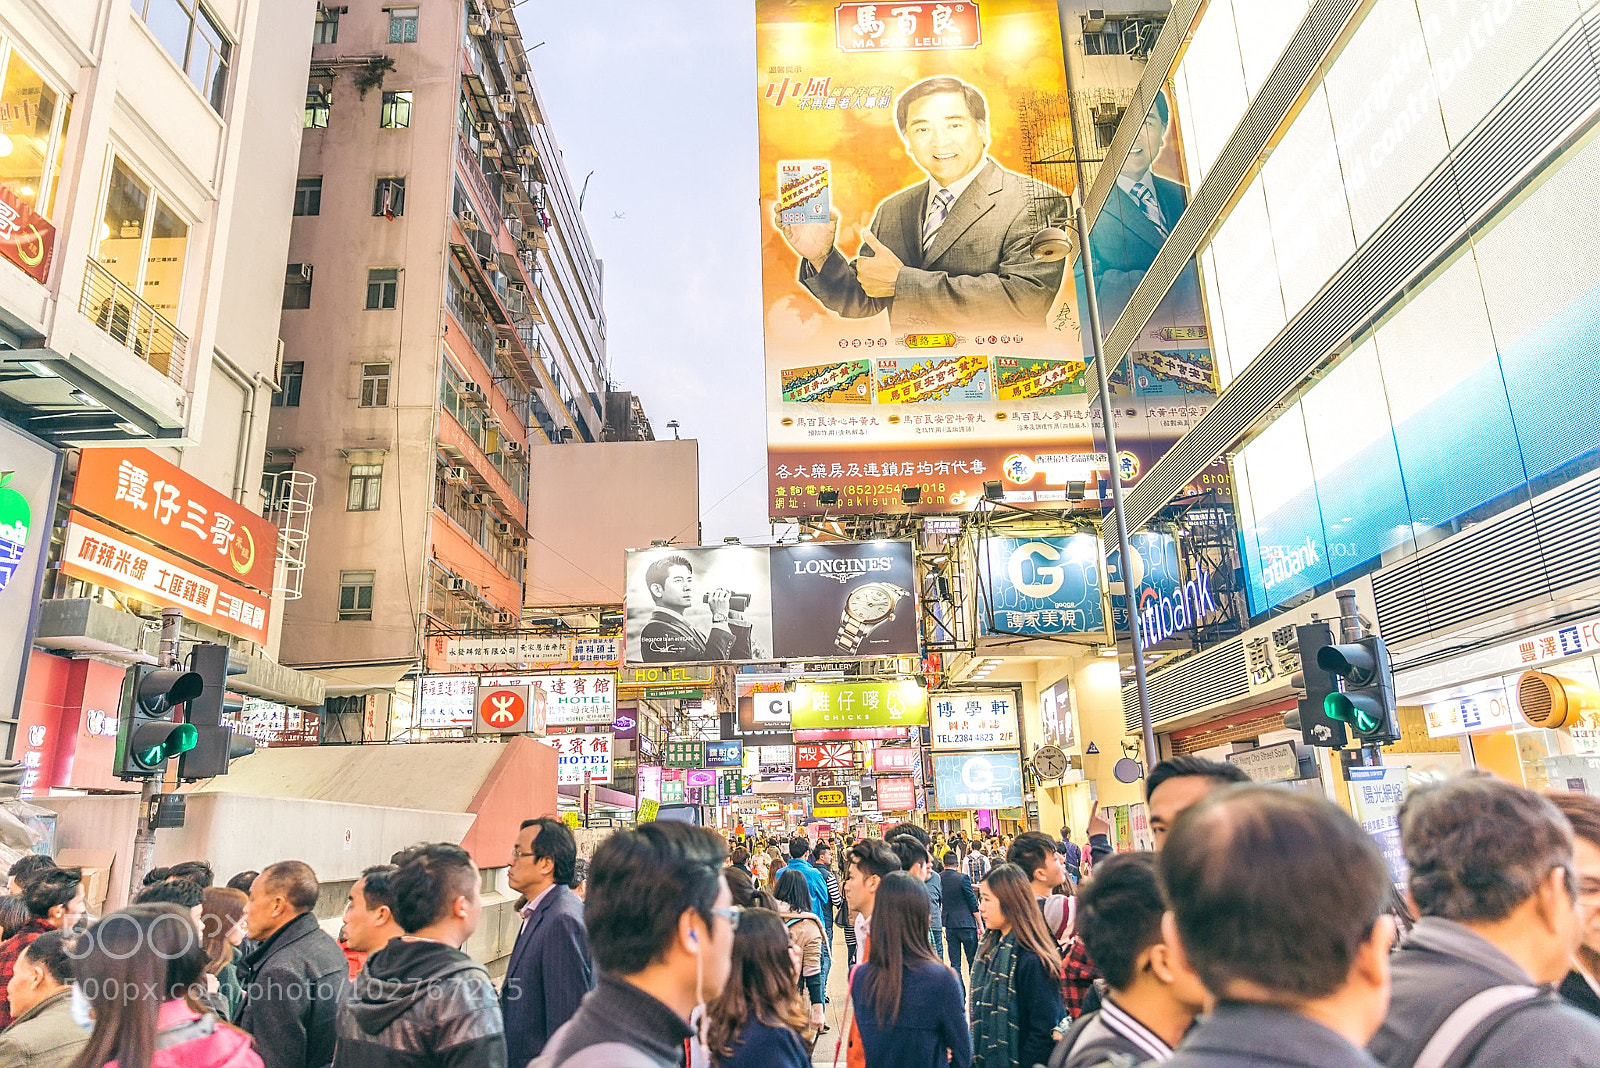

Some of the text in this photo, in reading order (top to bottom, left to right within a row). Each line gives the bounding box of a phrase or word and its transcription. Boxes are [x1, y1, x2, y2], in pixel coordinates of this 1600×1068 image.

[853, 4, 961, 38] 馬百良
[853, 38, 875, 48] MA
[915, 36, 962, 46] LEUNG
[766, 77, 831, 107] 中風
[798, 96, 891, 110] 不再是老人專利
[775, 458, 987, 479] 各大藥房及連鎖店均有代售
[114, 459, 236, 556] 譚仔三哥
[794, 556, 893, 575] LONGINES
[78, 535, 266, 631] 麻辣米線 土匪雞翼 三哥原創
[1006, 610, 1077, 628] 護家美視
[1518, 636, 1557, 664] 豐澤
[635, 667, 691, 682] HOTEL
[812, 663, 853, 671] JEWELLERY
[558, 696, 611, 704] HOTEL
[936, 700, 1010, 718] 博學軒
[937, 734, 973, 743] TEL:2384
[999, 732, 1014, 741] 2/F
[558, 755, 609, 764] HOTEL
[799, 753, 817, 761] MX
